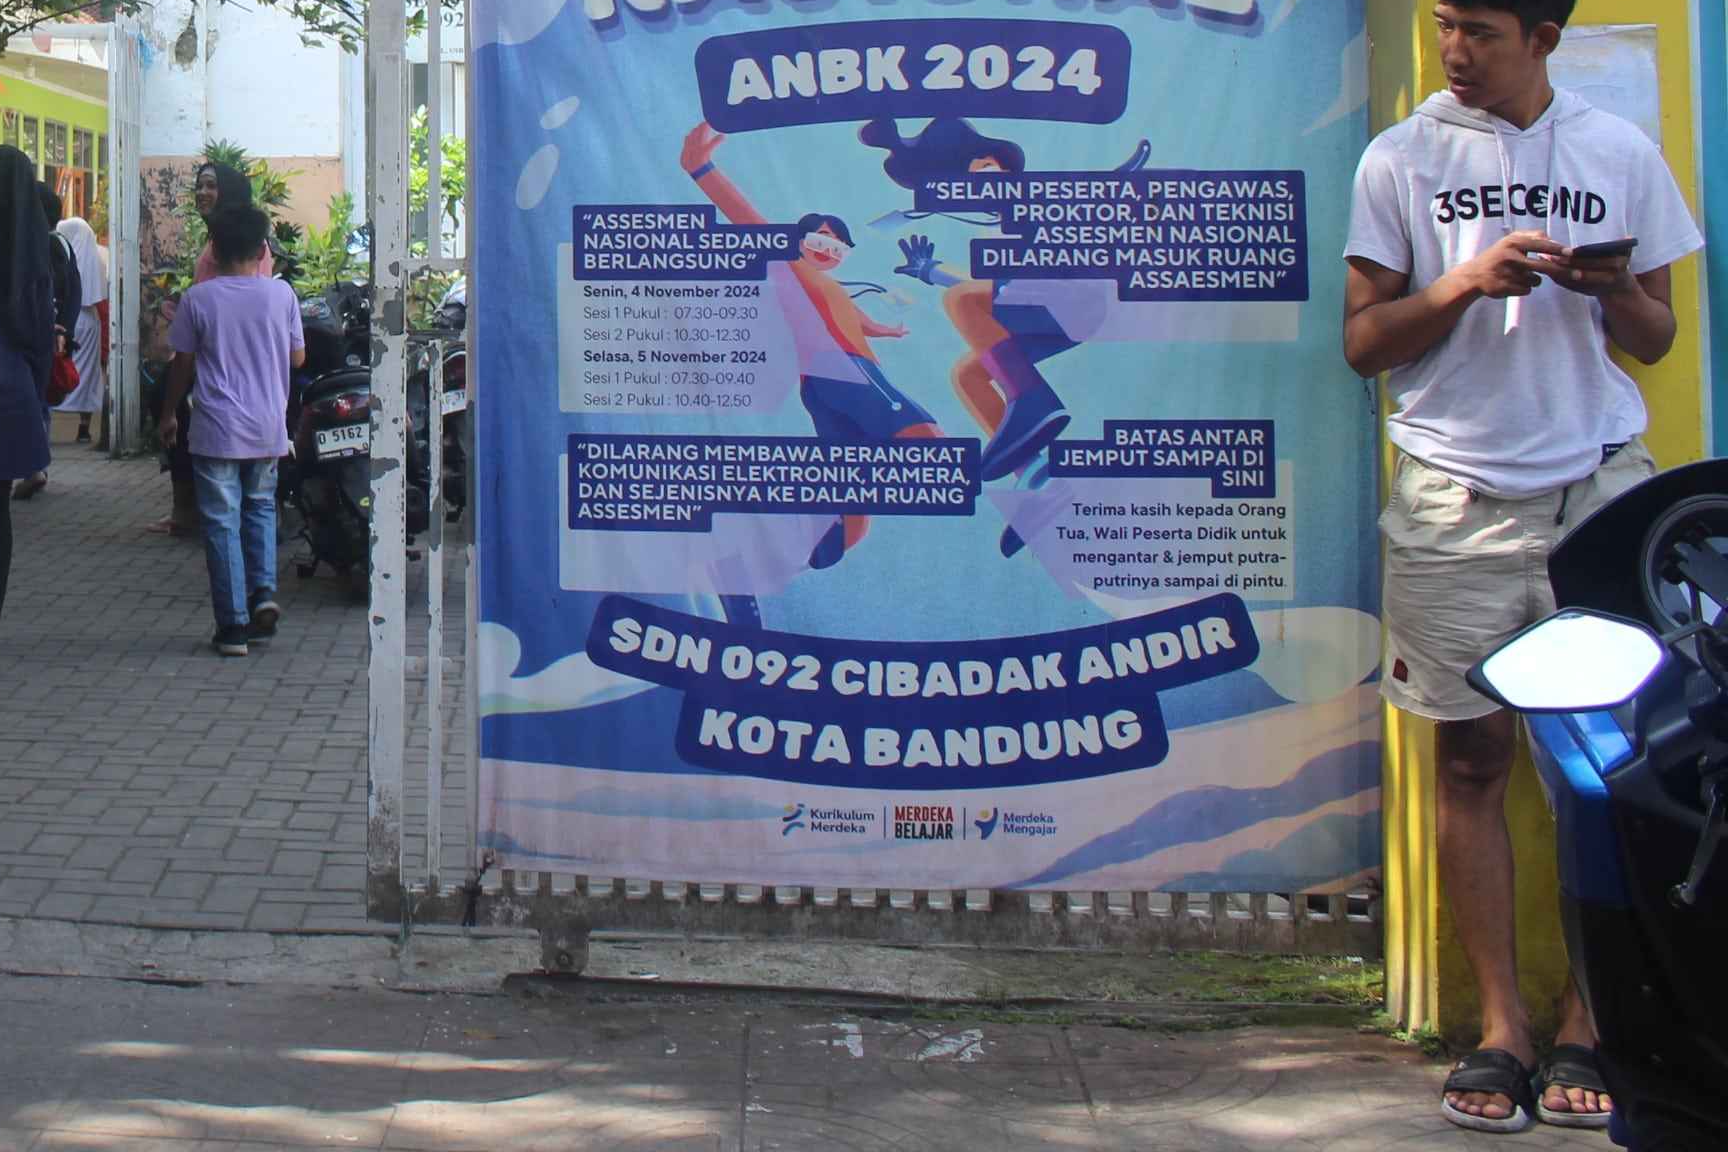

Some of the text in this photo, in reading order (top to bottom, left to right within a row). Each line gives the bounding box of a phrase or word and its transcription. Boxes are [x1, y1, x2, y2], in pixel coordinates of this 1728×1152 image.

[726, 42, 1102, 106] ANBK 2024
[1029, 181, 1141, 201] PESERTA,
[1148, 180, 1294, 201] PENGAWAS,
[1014, 202, 1294, 224] PROKTOR, DAN TEKNISI
[583, 233, 788, 249] NASIONAL SEDANG
[1034, 225, 1296, 244] ASSESMEN NASIONAL
[983, 248, 1296, 267] DILARANG MASUK RUANG
[583, 285, 760, 299] Senin, 4 November 2024
[583, 307, 611, 319] Sesi
[623, 307, 661, 319] Pukul
[583, 328, 611, 341] Sesi
[626, 328, 664, 341] Pukul
[583, 350, 767, 364] Selasa, 5 November 2024
[583, 372, 611, 384] Sesi
[623, 372, 661, 384] Pukul
[583, 393, 611, 406] Sesi
[626, 393, 664, 406] Pukul
[1115, 429, 1265, 446] BATAS ANTAR
[704, 444, 823, 463] MEMBAWA
[830, 446, 966, 464] PERANGKAT
[1059, 449, 1265, 467] JEMPUT SAMPAI DI
[578, 462, 972, 485] KOMUNIKASI ELEKTRONIK, KAMERA,
[1222, 470, 1265, 487] SINI
[578, 483, 964, 504] DAN SEJENISNYA KE DALAM RUANG
[1073, 503, 1287, 520] Terima kasih kepada Orang
[1056, 526, 1287, 543] Tua, Wali Peserta Didik untuk
[1073, 550, 1287, 567] mengantar & jemput putra-
[1093, 574, 1160, 590] putrinya
[1164, 574, 1219, 590] sampai
[1224, 573, 1239, 588] di
[608, 617, 1237, 698] SDN 092 CIBADAK ANDIR
[698, 708, 1143, 768] KOTA BANDUNG
[809, 808, 875, 822] Kurikulum
[895, 806, 954, 823] MERDEKA
[1003, 812, 1054, 824] Merdeka
[809, 821, 866, 834] Merdeka
[895, 823, 954, 840] BELAJAR
[1003, 823, 1057, 836] Mengajar
